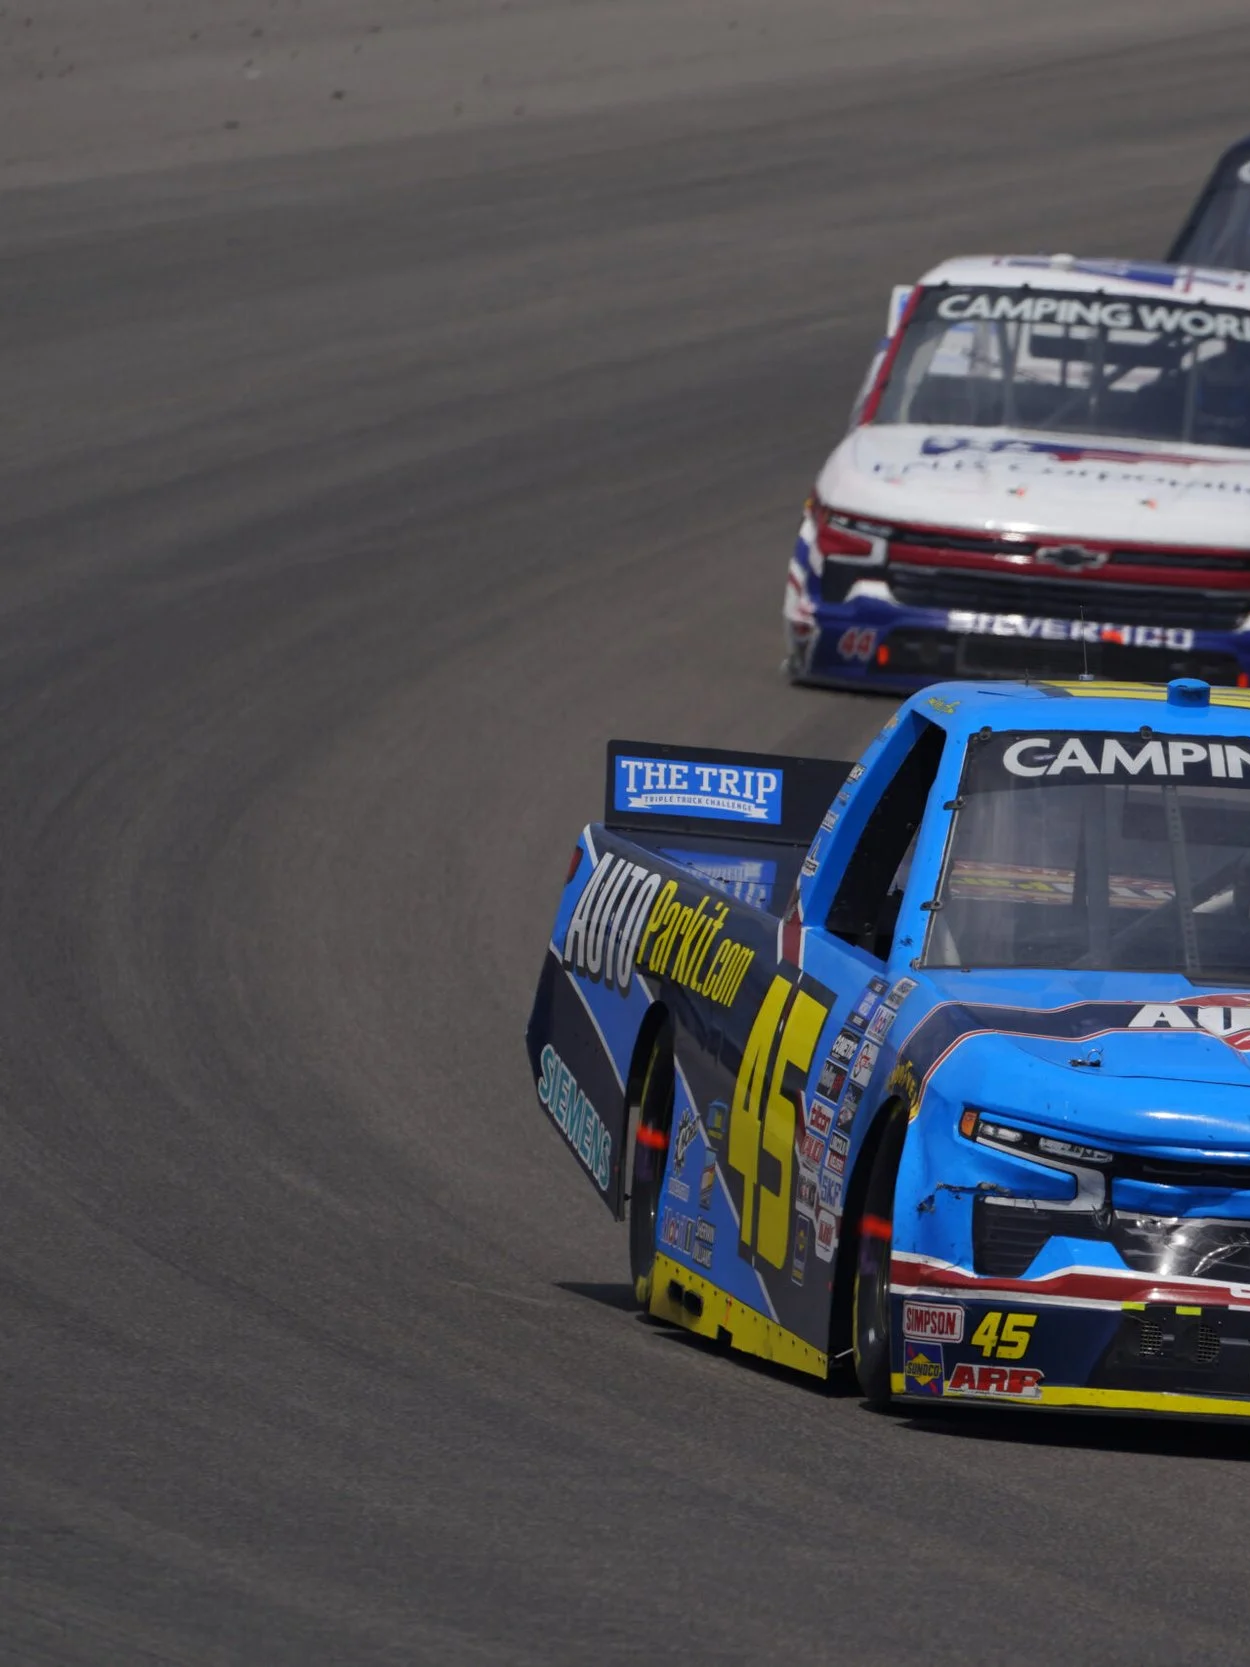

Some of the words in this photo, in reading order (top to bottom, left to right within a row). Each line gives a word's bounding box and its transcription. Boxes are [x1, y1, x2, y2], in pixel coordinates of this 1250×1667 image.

[937, 296, 1133, 329] CAMPING
[837, 626, 877, 662] 44
[621, 760, 688, 793] THE
[695, 766, 777, 804] TRIP
[644, 795, 674, 804] TRIPLE
[676, 796, 703, 805] TRUCK
[705, 797, 753, 812] CHALLENGE
[538, 1043, 613, 1192] SIEMENS
[728, 973, 828, 1270] 45
[906, 1306, 957, 1336] SIMPSON
[971, 1311, 1038, 1360] 45
[906, 1362, 941, 1378] SUNOCO
[949, 1364, 1044, 1395] ARP
